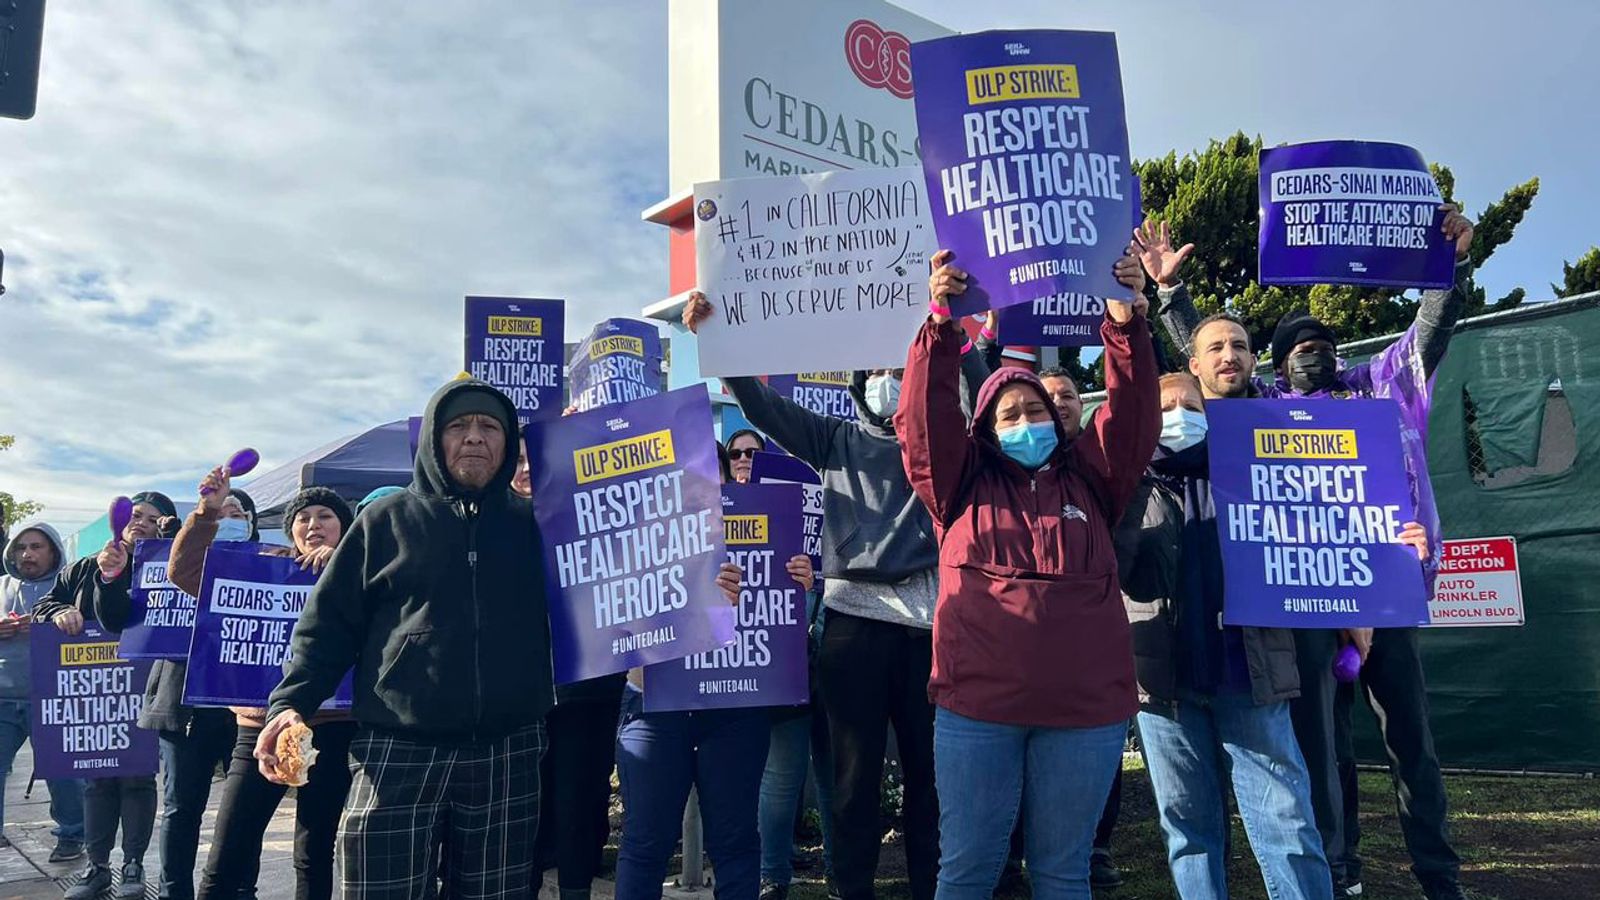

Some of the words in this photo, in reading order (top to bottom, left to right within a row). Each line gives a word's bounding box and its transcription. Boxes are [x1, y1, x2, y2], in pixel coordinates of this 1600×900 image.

[974, 72, 1006, 98] ULP
[1010, 70, 1072, 94] STRIKE:
[963, 105, 1090, 158] RESPECT
[745, 150, 815, 176] MARI
[941, 152, 1123, 216] HEALTHCARE
[1277, 173, 1377, 196] CEDARS-SINAI
[767, 204, 781, 222] IN
[787, 180, 919, 230] CALIFORNIA
[1284, 202, 1320, 224] STOP
[1323, 202, 1349, 223] THE
[1351, 202, 1410, 226] ATTACKS
[1414, 204, 1434, 227] ON
[982, 200, 1098, 258] HEROES
[1286, 224, 1373, 246] HEALTHCARE
[1376, 225, 1429, 249] HEROES.
[782, 240, 797, 258] IN
[814, 260, 833, 277] ALL
[838, 259, 853, 275] OF
[857, 258, 874, 274] US
[1009, 259, 1086, 285] #UNITED4ALL
[722, 291, 749, 326] WE
[762, 287, 848, 320] DESERVE
[858, 281, 920, 312] MORE
[491, 319, 506, 332] ULP
[507, 320, 538, 333] STRIKE:
[1042, 324, 1092, 336] #UNITED4ALL
[484, 338, 544, 362] RESPECT
[592, 342, 608, 355] ULP
[610, 338, 640, 354] STRIKE:
[471, 362, 558, 387] HEALTHCARE
[589, 356, 646, 386] RESPECT
[1261, 433, 1289, 454] ULP
[1293, 433, 1350, 454] STRIKE:
[580, 449, 609, 477] ULP
[613, 437, 668, 471] STRIKE:
[1251, 464, 1368, 503] RESPECT
[573, 470, 684, 536] RESPECT
[1228, 503, 1401, 544] HEALTHCARE
[555, 508, 715, 588] HEALTHCARE
[1451, 544, 1494, 556] DEPT.
[1263, 546, 1373, 587] HEROES
[593, 564, 688, 629] HEROES
[1439, 579, 1475, 590] AUTO
[147, 590, 174, 607] STOP
[1283, 598, 1360, 613] #UNITED4ALL
[143, 609, 196, 627] HEALTHC
[1432, 608, 1481, 618] LINCOLN
[1485, 607, 1518, 617] BLVD.
[221, 617, 257, 640] STOP
[261, 620, 288, 643] THE
[612, 625, 676, 655] #UNITED4ALL
[65, 647, 85, 662] ULP
[86, 645, 119, 661] STRIK
[57, 667, 134, 696] RESPECT
[699, 678, 759, 694] #UNITED4ALL
[62, 722, 130, 752] HEROES
